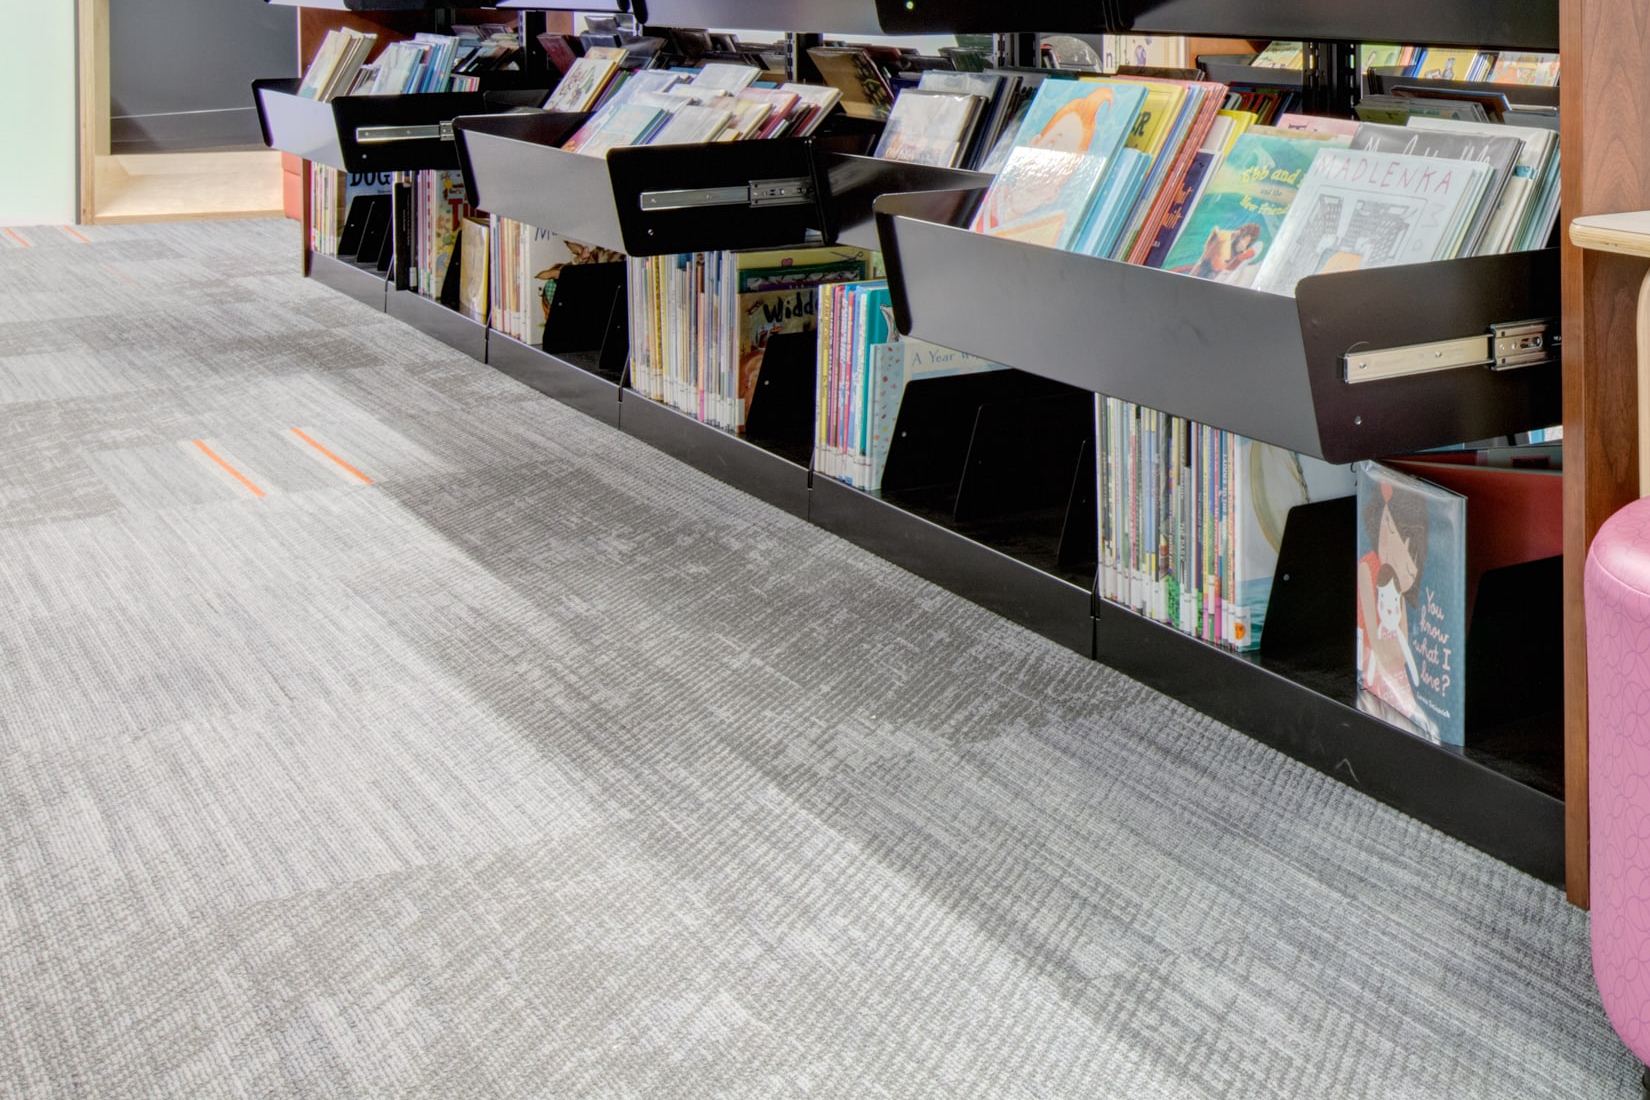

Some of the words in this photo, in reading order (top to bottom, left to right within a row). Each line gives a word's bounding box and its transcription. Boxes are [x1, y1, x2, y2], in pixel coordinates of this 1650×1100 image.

[1313, 154, 1453, 195] MADLENKA
[929, 350, 955, 363] Year
[1425, 587, 1445, 621] You
[1419, 606, 1450, 644] know
[1412, 638, 1440, 666] what
[1442, 649, 1451, 670] I
[1420, 661, 1451, 698] love?
